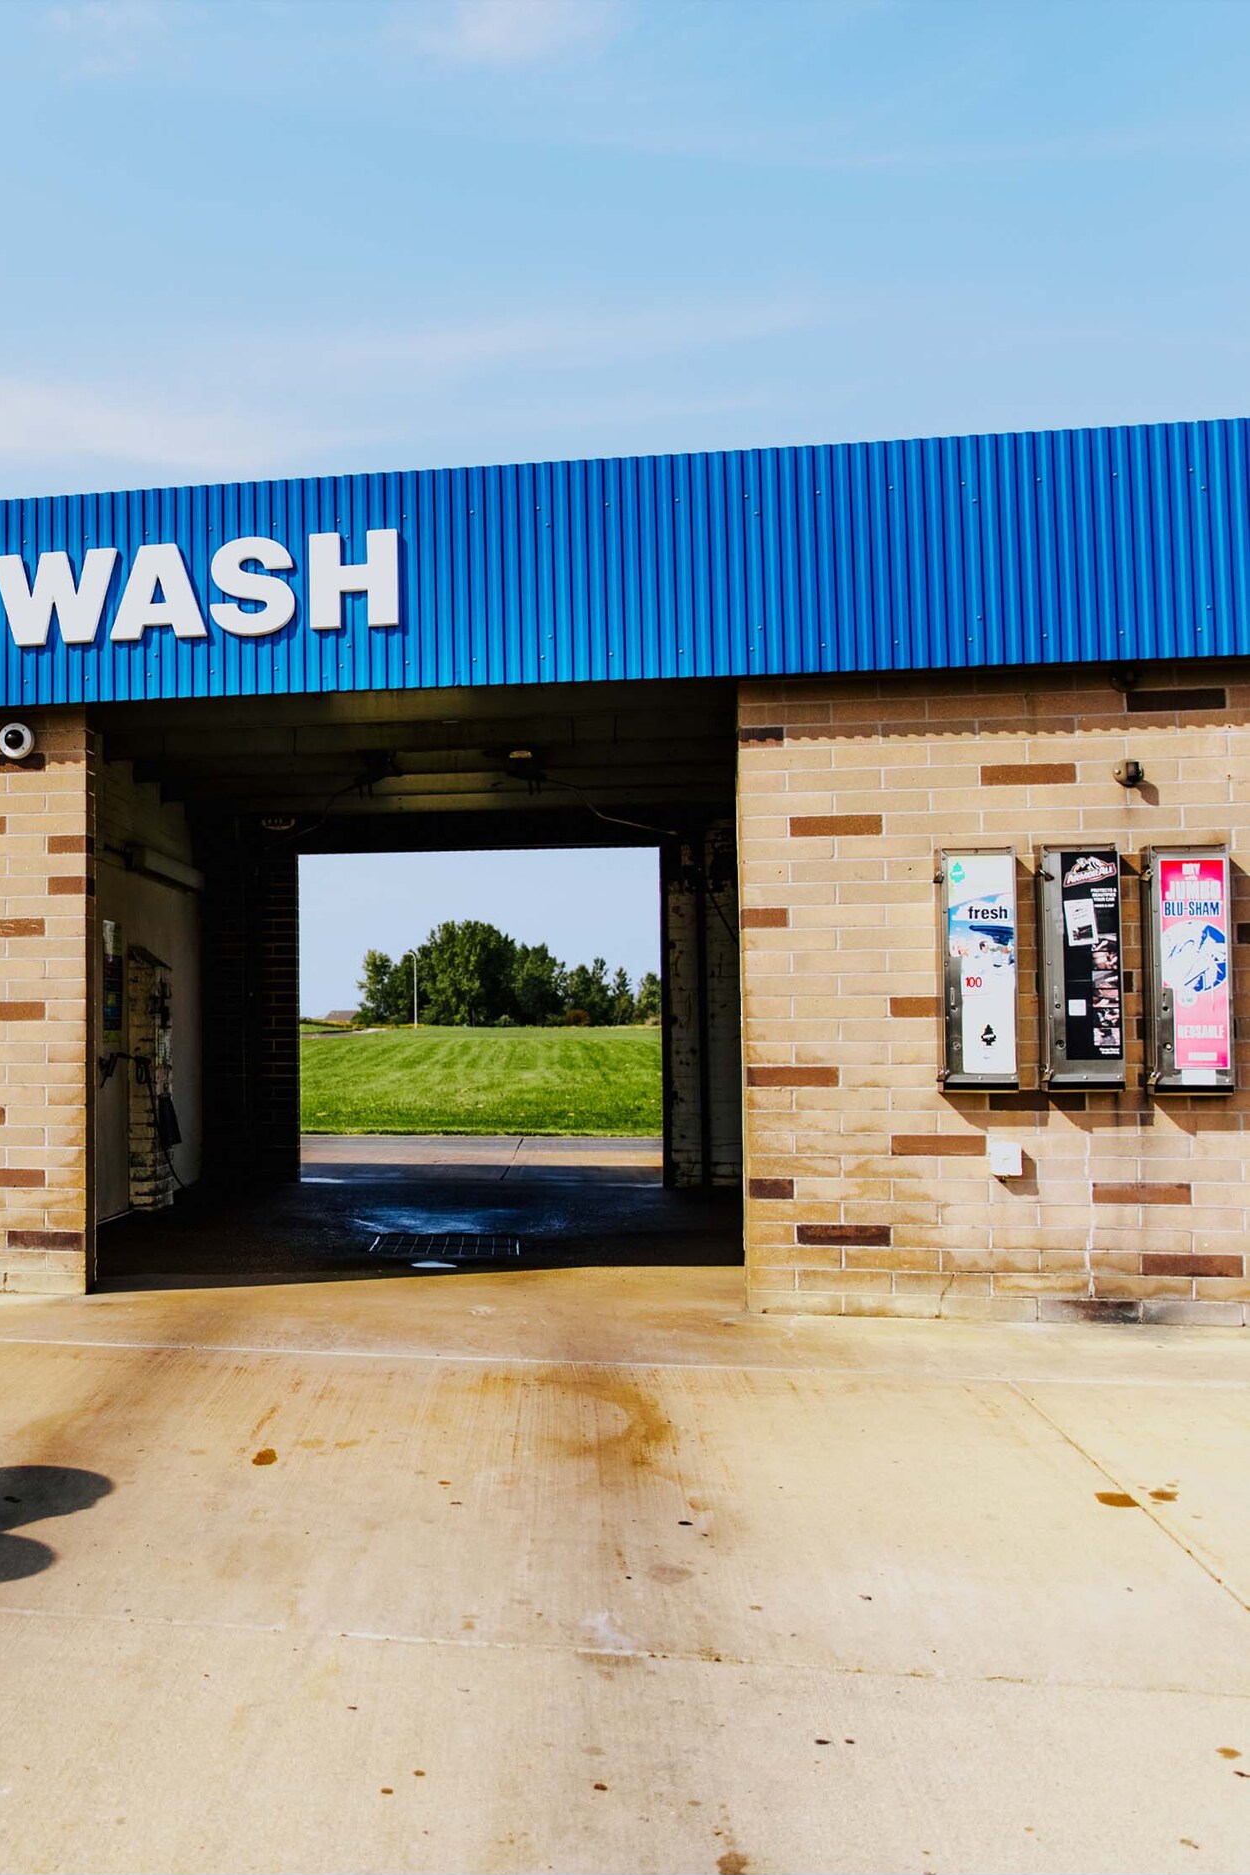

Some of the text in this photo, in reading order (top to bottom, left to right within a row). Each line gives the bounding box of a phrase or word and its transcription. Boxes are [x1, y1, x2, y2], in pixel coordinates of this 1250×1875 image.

[968, 906, 1008, 919] fresh
[1165, 902, 1219, 916] BLU-SHAM
[965, 976, 982, 987] 100
